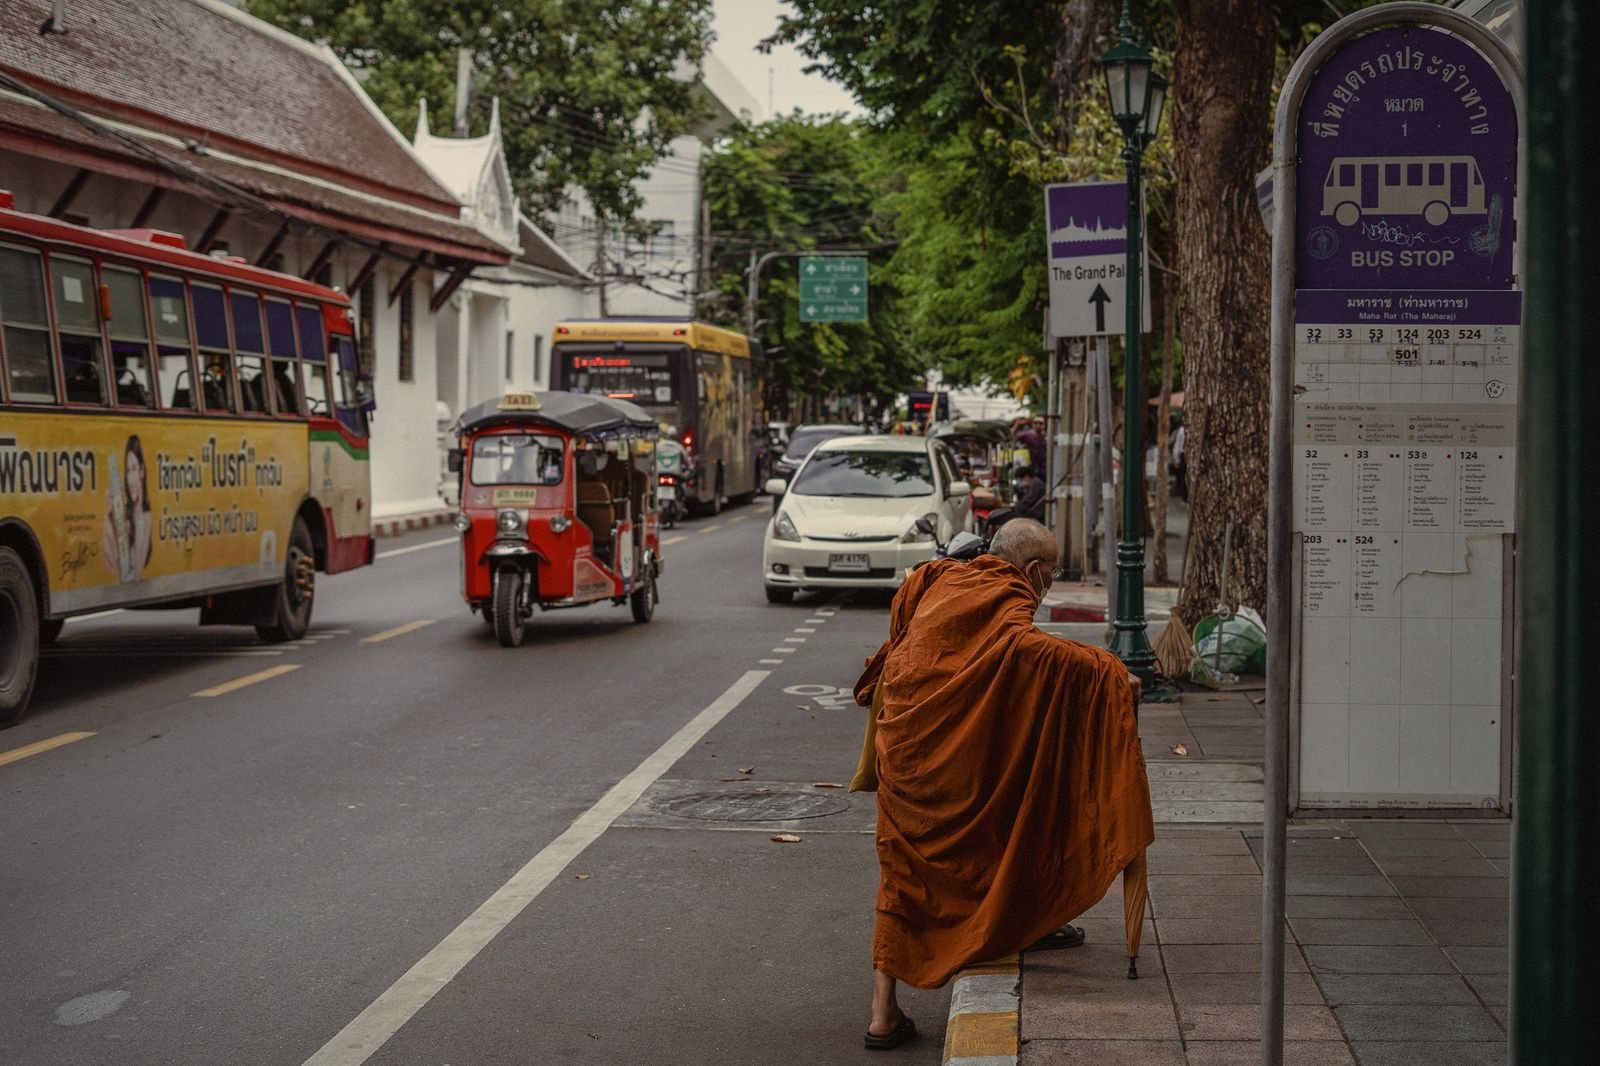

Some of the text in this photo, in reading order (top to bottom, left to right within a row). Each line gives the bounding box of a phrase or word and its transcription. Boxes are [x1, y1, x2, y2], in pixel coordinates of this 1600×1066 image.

[1307, 46, 1489, 138] ที่หยุดรถประจำทาง
[1384, 97, 1424, 112] หมวด
[1351, 250, 1455, 267] BUS STOP
[1052, 267, 1072, 281] The
[1074, 264, 1106, 280] Grand
[1347, 295, 1469, 309] มหาราช (ท่ามหาราช)
[1359, 312, 1457, 321] Maha Rat (Tha Maharaj)
[1307, 329, 1321, 338] 32
[1337, 329, 1352, 338] 33
[1369, 329, 1383, 338] 53
[1397, 329, 1418, 339] 124
[1427, 329, 1450, 339] 203
[1458, 329, 1481, 339] 524
[1395, 350, 1418, 359] 501
[1305, 450, 1318, 458] 32
[1356, 450, 1369, 459] 33
[1408, 451, 1420, 459] 53
[1460, 451, 1478, 460] 124
[1303, 535, 1322, 544] 203
[1355, 536, 1373, 544] 524
